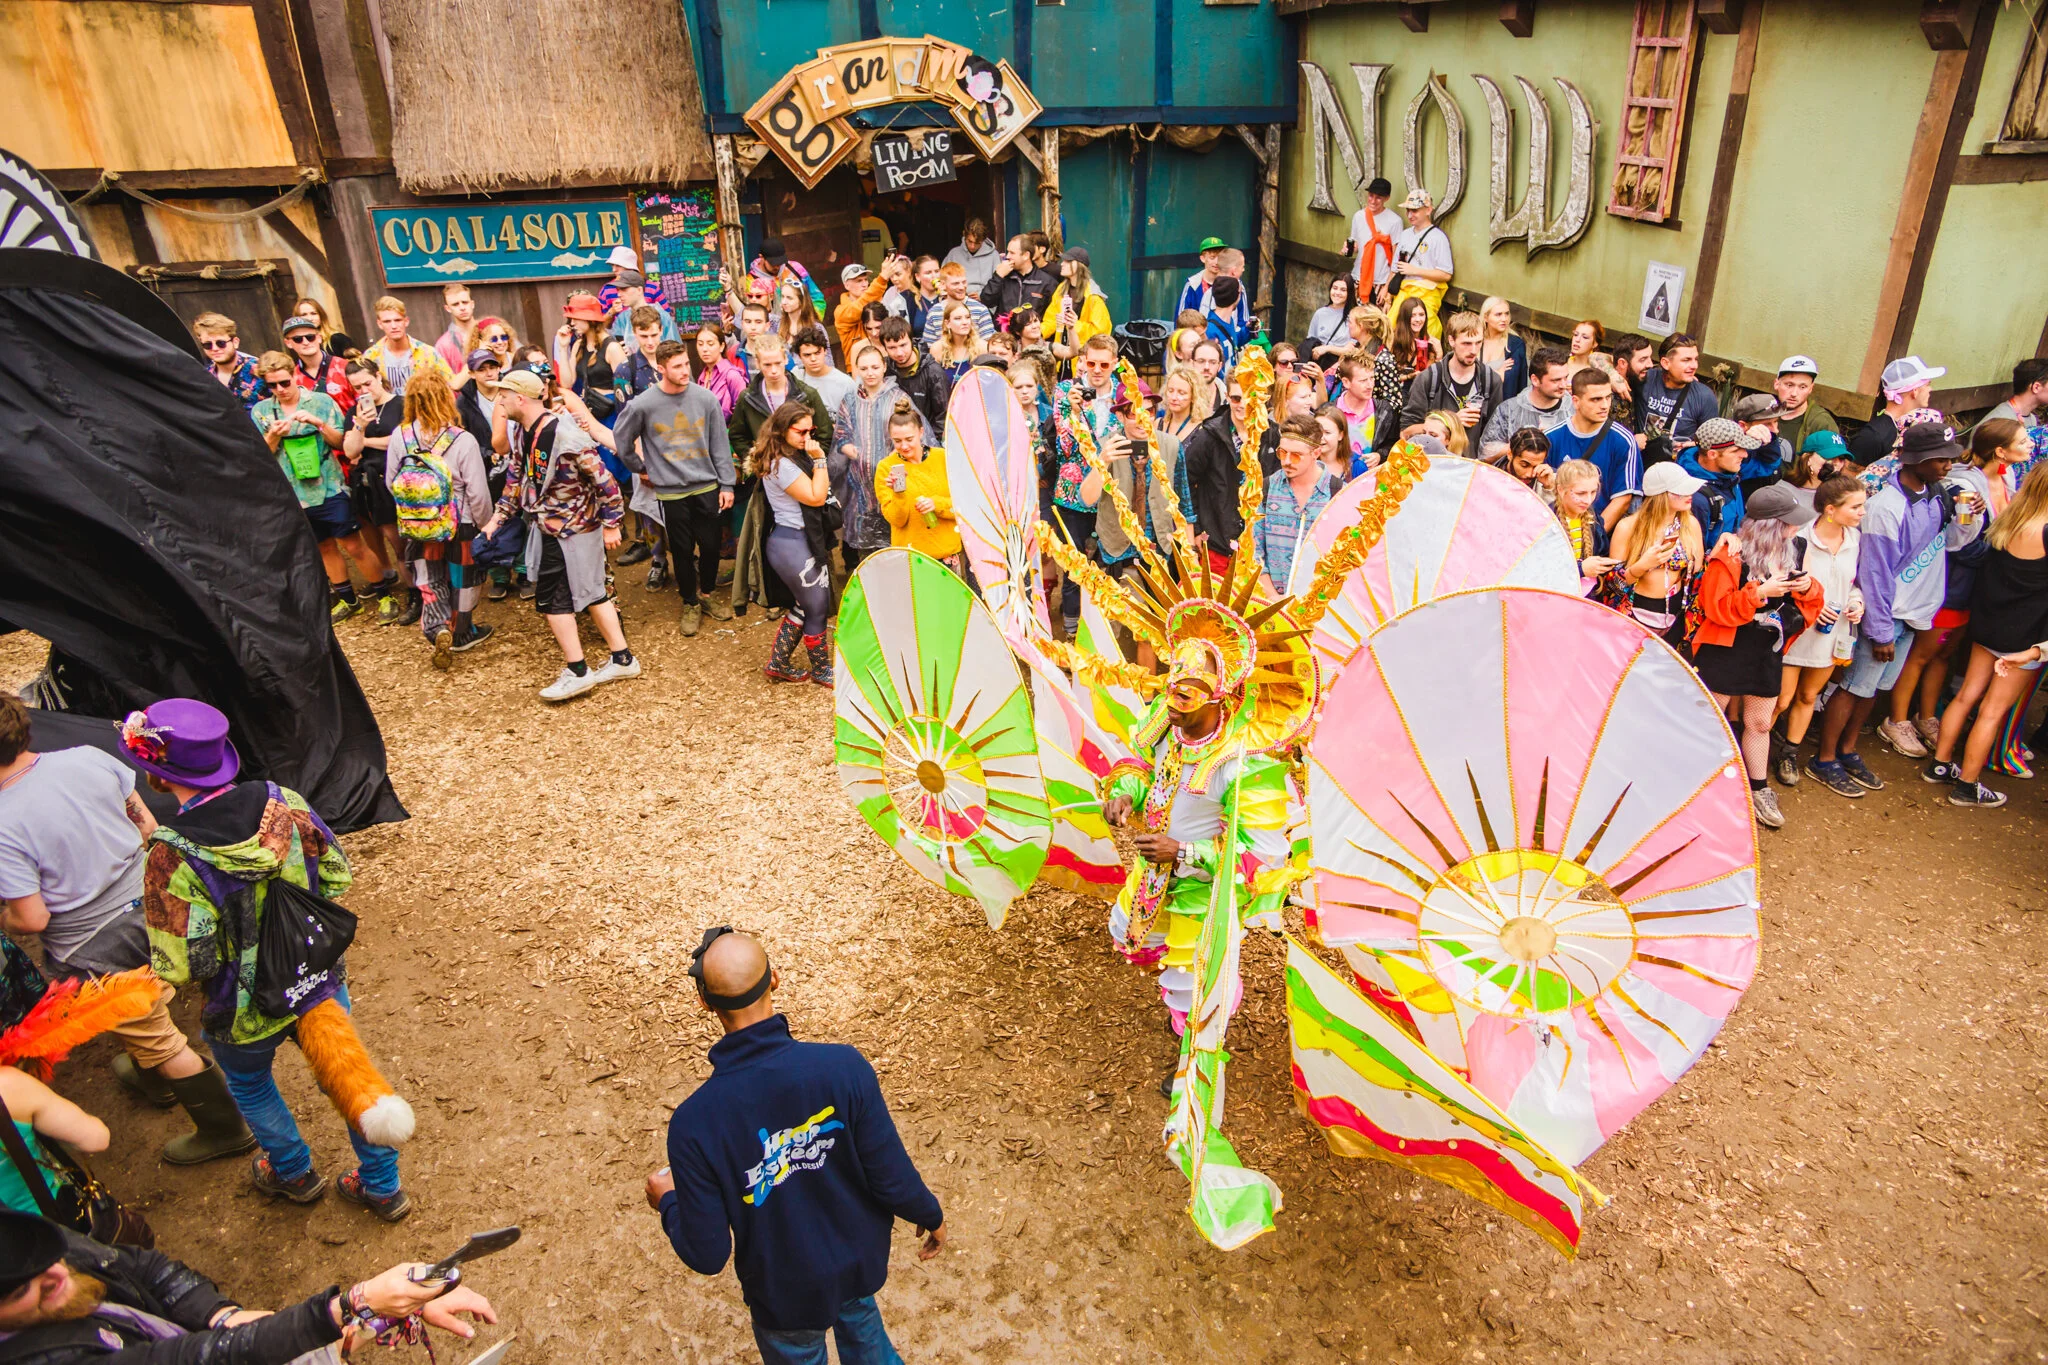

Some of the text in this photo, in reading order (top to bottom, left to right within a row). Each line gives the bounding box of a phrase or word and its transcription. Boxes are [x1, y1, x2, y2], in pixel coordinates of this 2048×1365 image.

[769, 47, 1014, 166] grandms
[886, 158, 950, 189] ROOM
[1300, 60, 1597, 263] NOW
[383, 211, 625, 256] COAL4SOLE
